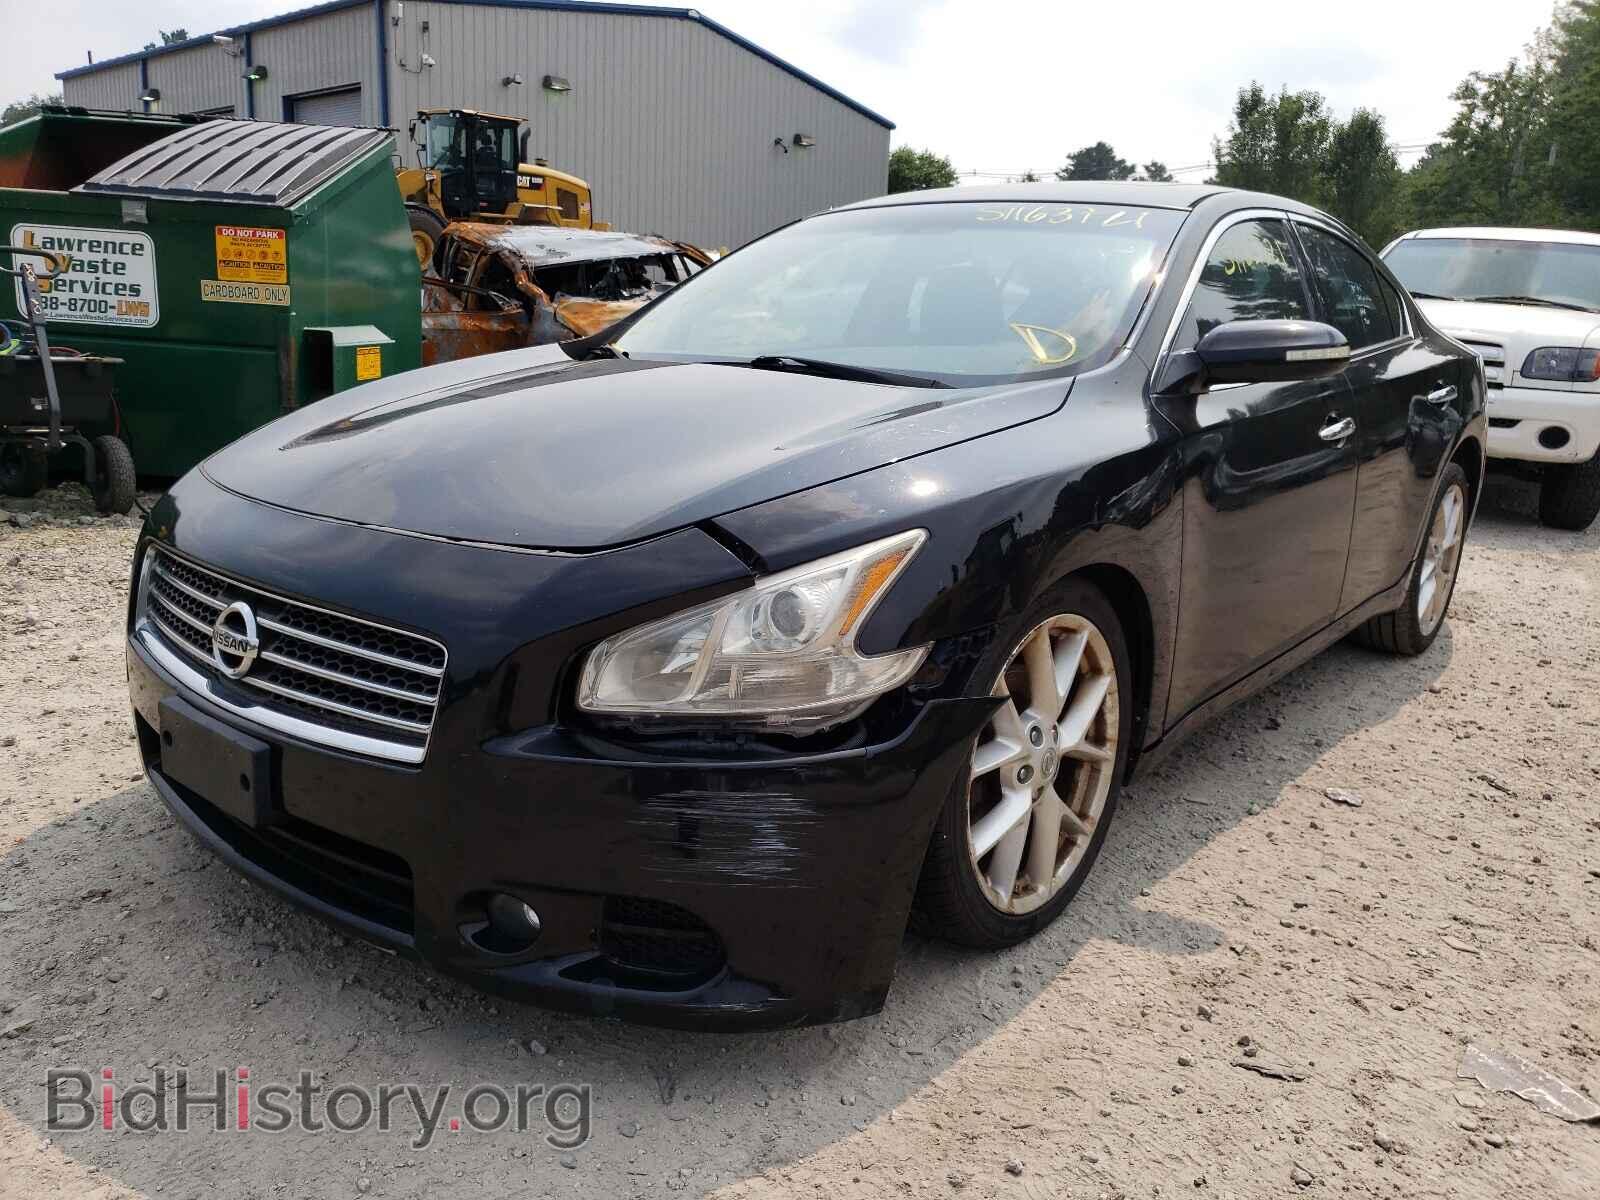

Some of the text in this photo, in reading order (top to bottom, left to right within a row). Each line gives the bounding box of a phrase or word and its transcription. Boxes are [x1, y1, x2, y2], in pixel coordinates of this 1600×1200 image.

[517, 175, 530, 187] CAT
[222, 228, 279, 239] DO NOT PARK
[23, 230, 145, 257] Lawrence
[203, 283, 288, 302] CARDBOARD ONLY
[213, 629, 248, 653] NISSAN
